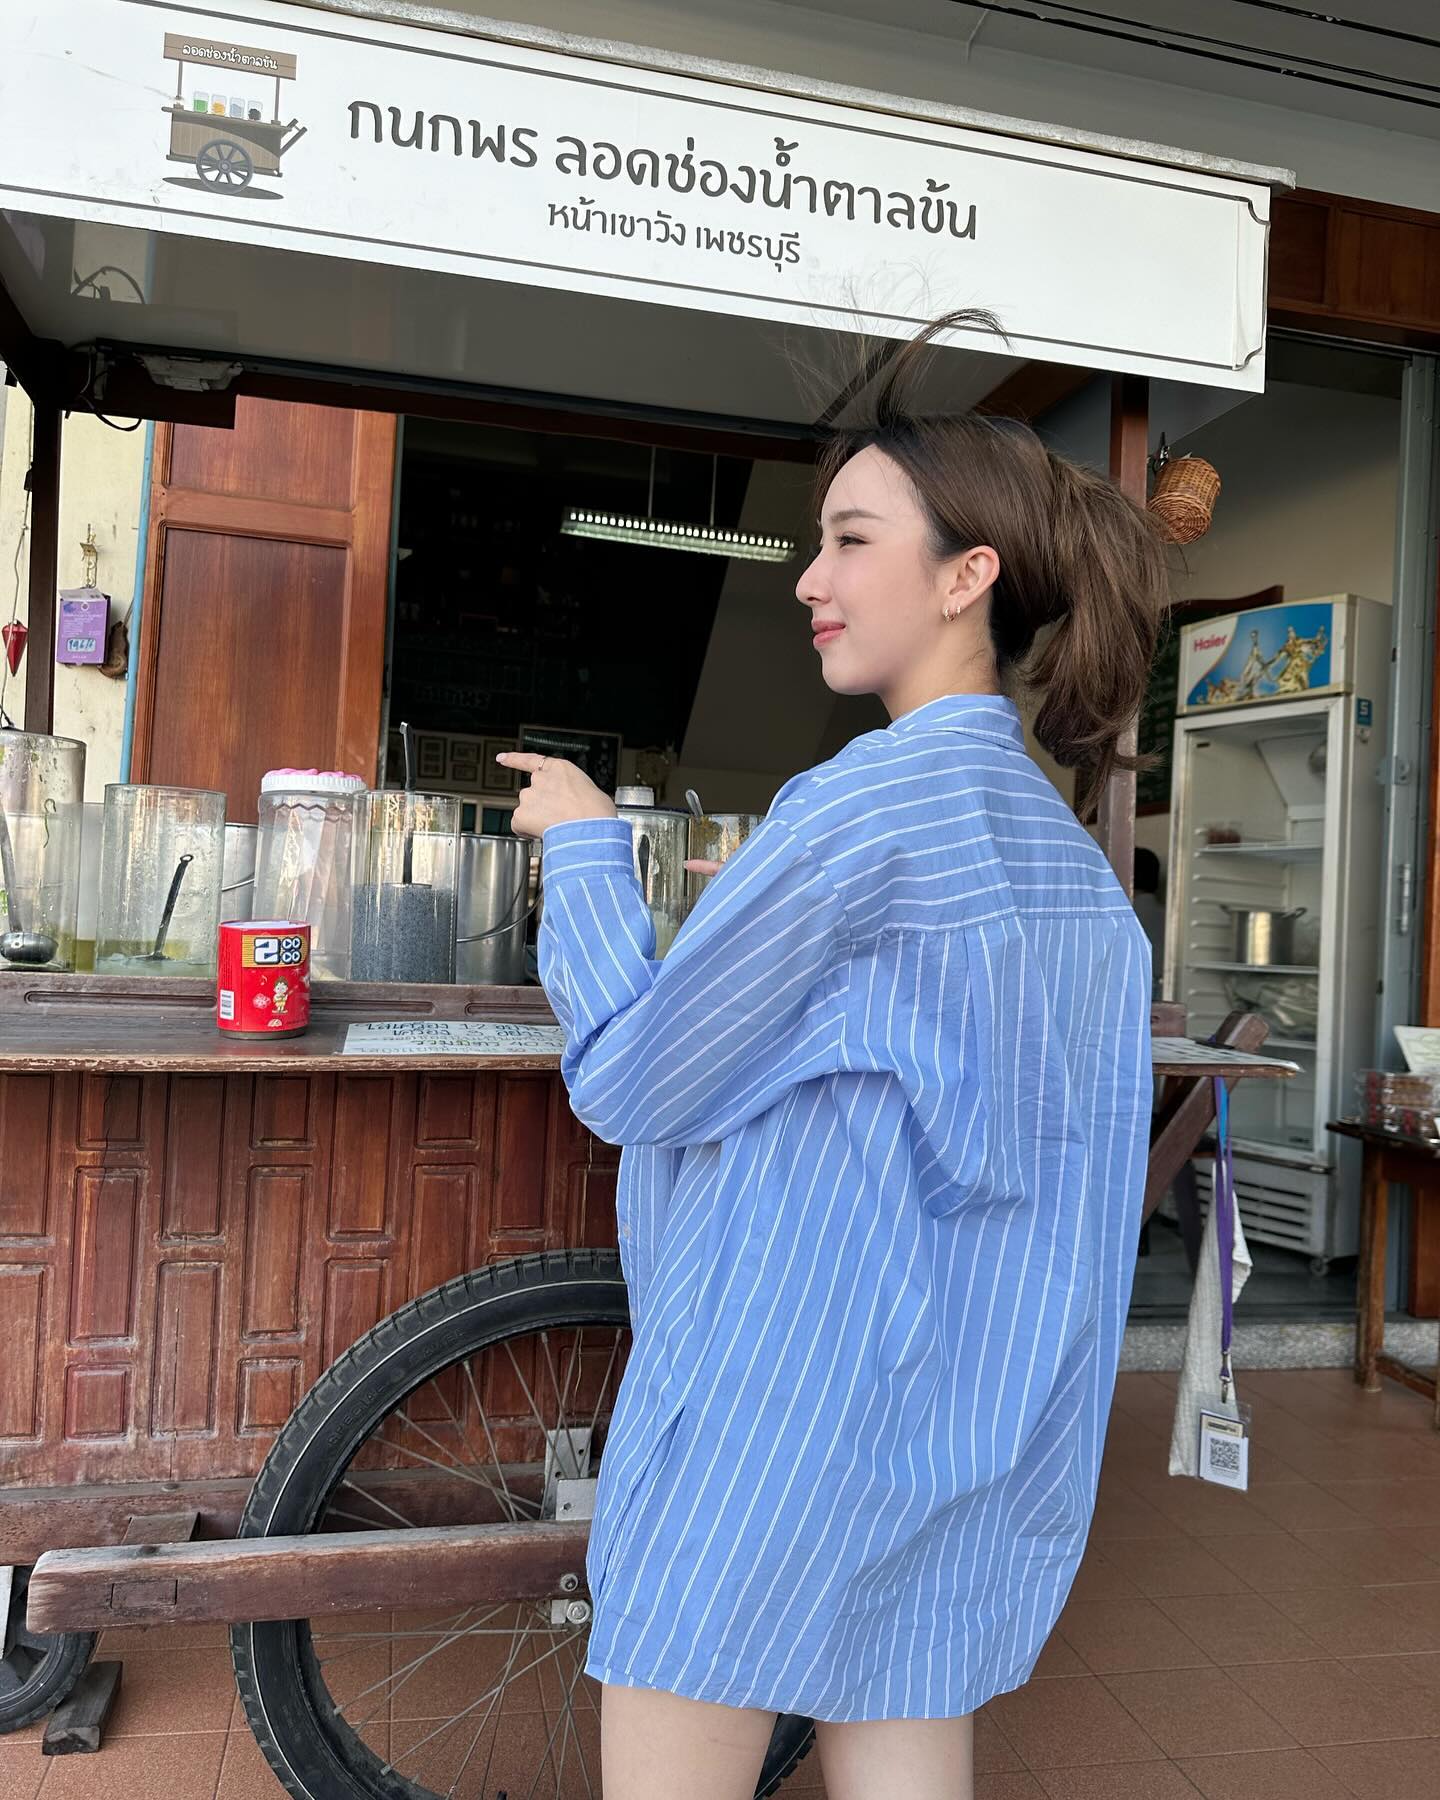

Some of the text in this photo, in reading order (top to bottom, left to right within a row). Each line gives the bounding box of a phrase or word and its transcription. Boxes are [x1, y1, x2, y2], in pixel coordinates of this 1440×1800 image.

[347, 100, 977, 240] กนกพร ลอดช่องน้ำตาลข้น
[548, 196, 800, 273] หน้าเขาวัง เพชรบุรี
[1193, 633, 1228, 652] Haier
